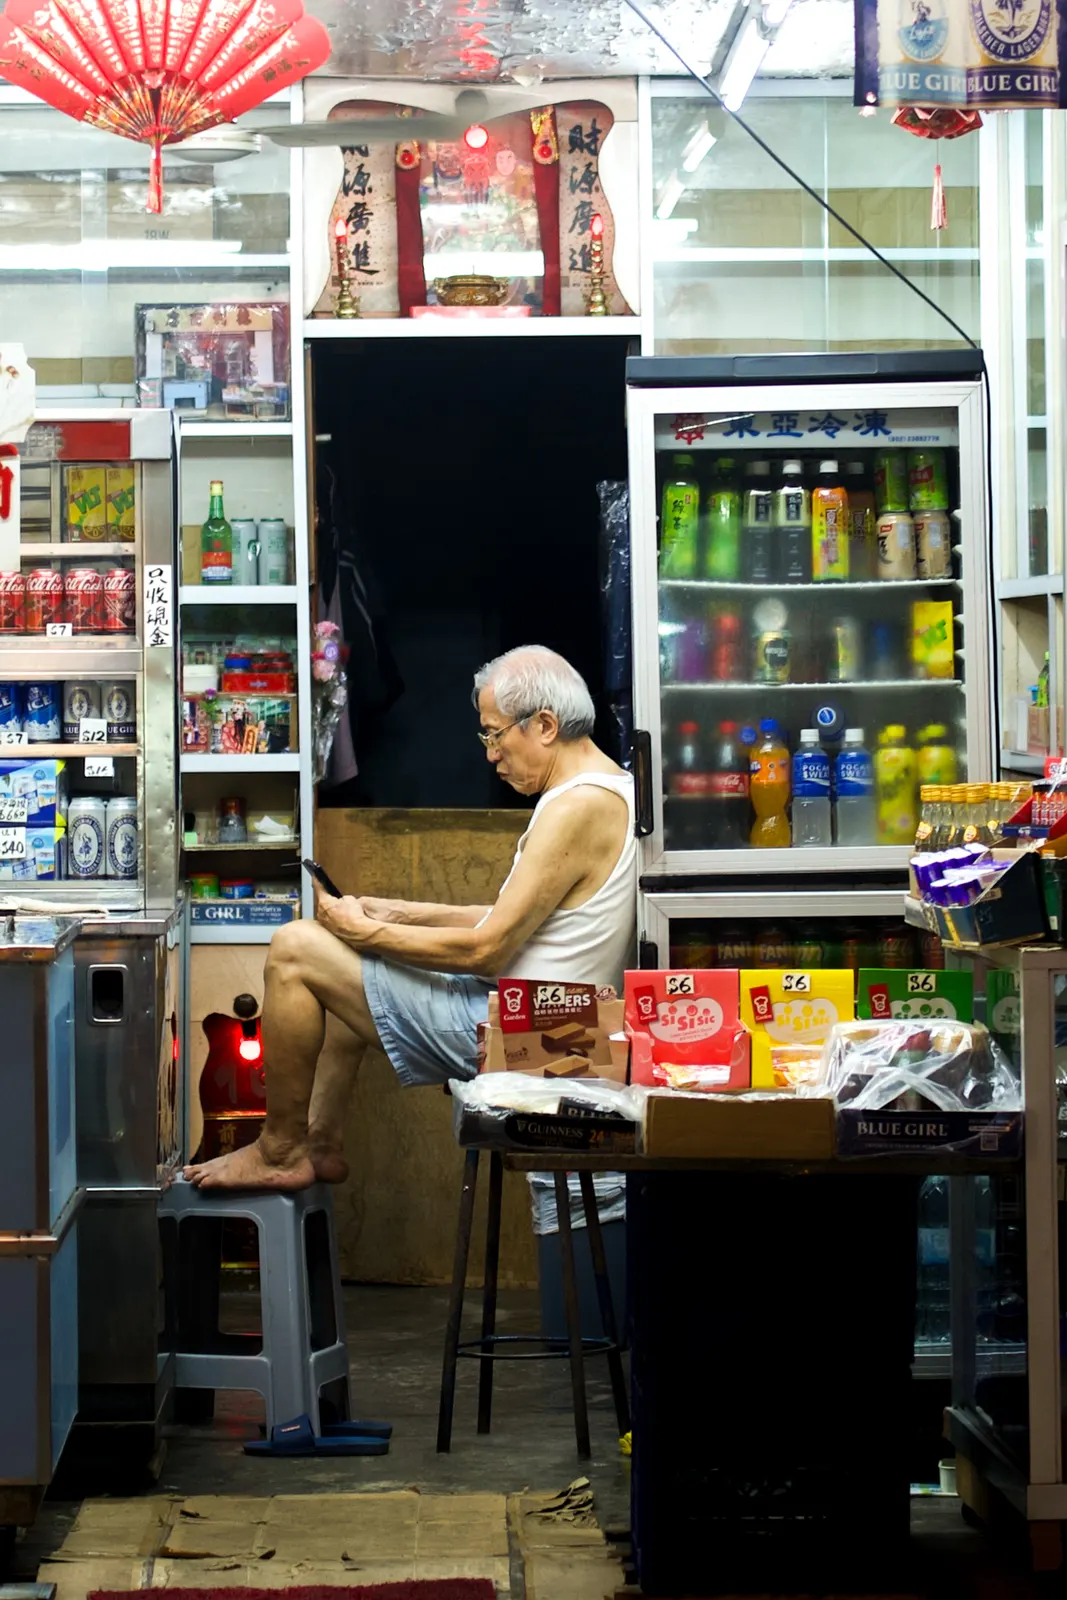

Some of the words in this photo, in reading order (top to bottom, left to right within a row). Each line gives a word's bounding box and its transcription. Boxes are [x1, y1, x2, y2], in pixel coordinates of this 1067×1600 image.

[1010, 38, 1042, 57] LAGER
[880, 73, 921, 91] LUE
[967, 74, 1011, 93] BLUE
[1015, 75, 1058, 93] GIRL
[146, 568, 169, 647] 只收現金
[27, 695, 52, 712] ICE
[82, 730, 105, 742] $12
[205, 907, 244, 919] GIRL
[717, 941, 751, 961] FANT
[668, 977, 692, 995] $6
[783, 976, 807, 991] $6
[910, 975, 933, 992] $6
[533, 994, 591, 1009] WERS
[540, 987, 561, 1004] $6
[504, 1013, 526, 1021] Garden
[528, 1121, 584, 1139] GUINNESS
[857, 1121, 902, 1136] BLUE
[904, 1122, 948, 1137] GIRL
